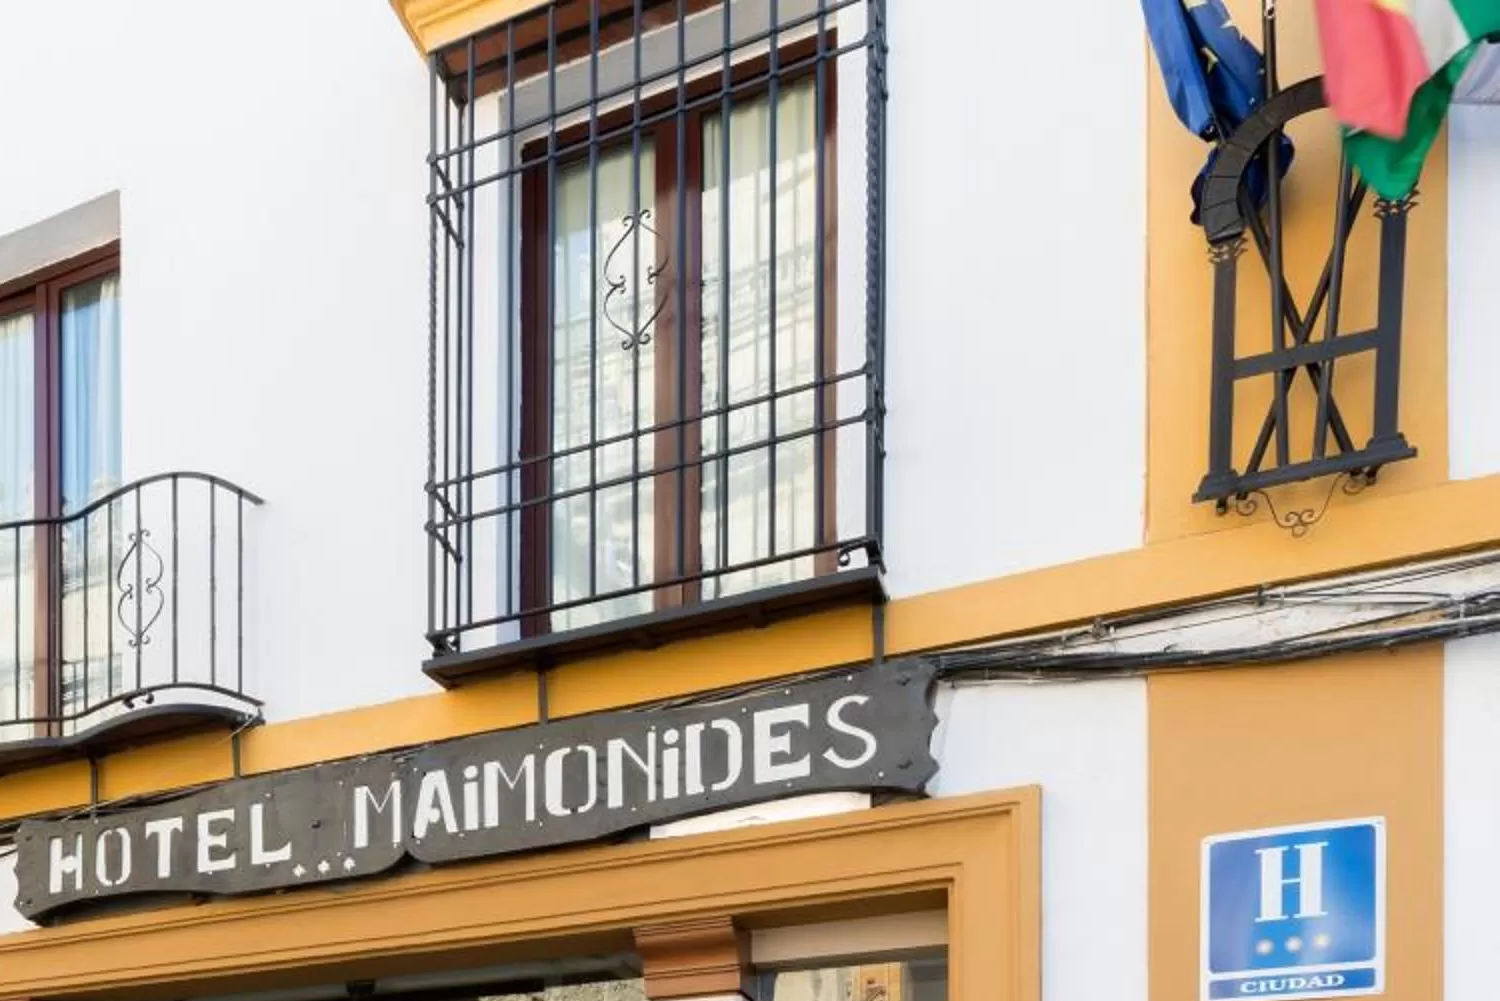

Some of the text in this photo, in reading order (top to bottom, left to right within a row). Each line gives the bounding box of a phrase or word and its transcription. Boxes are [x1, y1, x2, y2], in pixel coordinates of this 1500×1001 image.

[49, 803, 292, 893] HOTEL
[1254, 841, 1329, 922] H
[1240, 974, 1344, 993] CIUDAD
